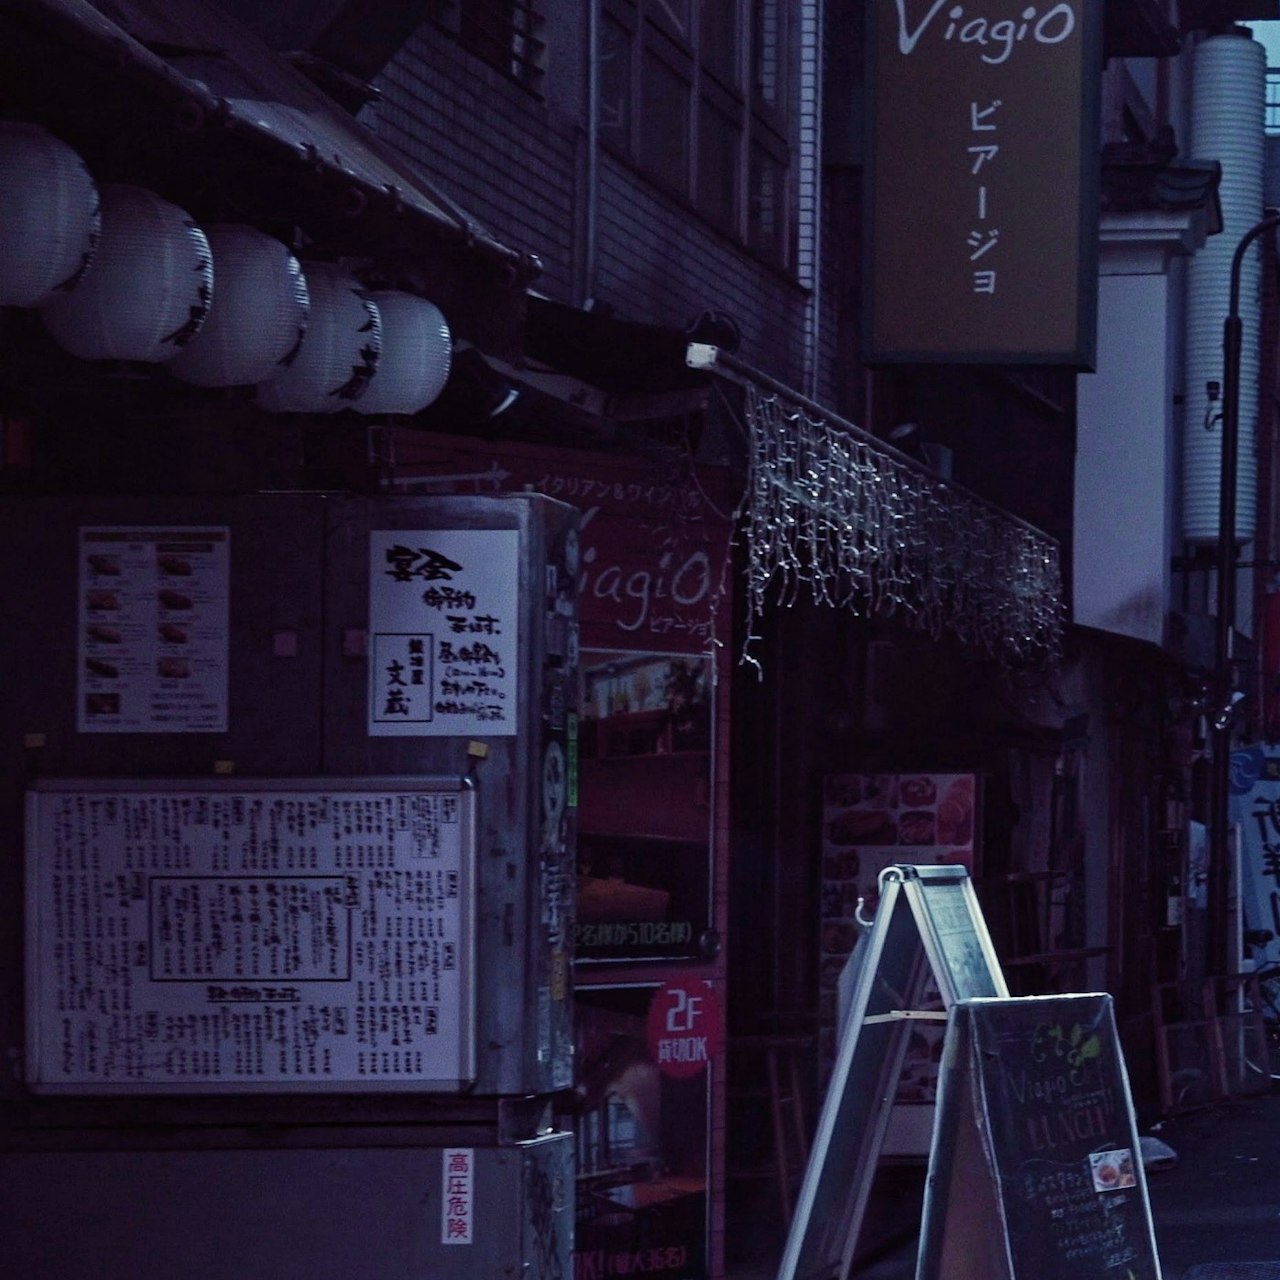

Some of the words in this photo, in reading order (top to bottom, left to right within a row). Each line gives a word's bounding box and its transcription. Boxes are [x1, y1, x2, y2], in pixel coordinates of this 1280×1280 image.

[966, 100, 1002, 295] ビアージョ
[386, 545, 463, 582] 宴会
[666, 988, 703, 1032] 2F
[446, 1153, 469, 1238] 高圧危険
